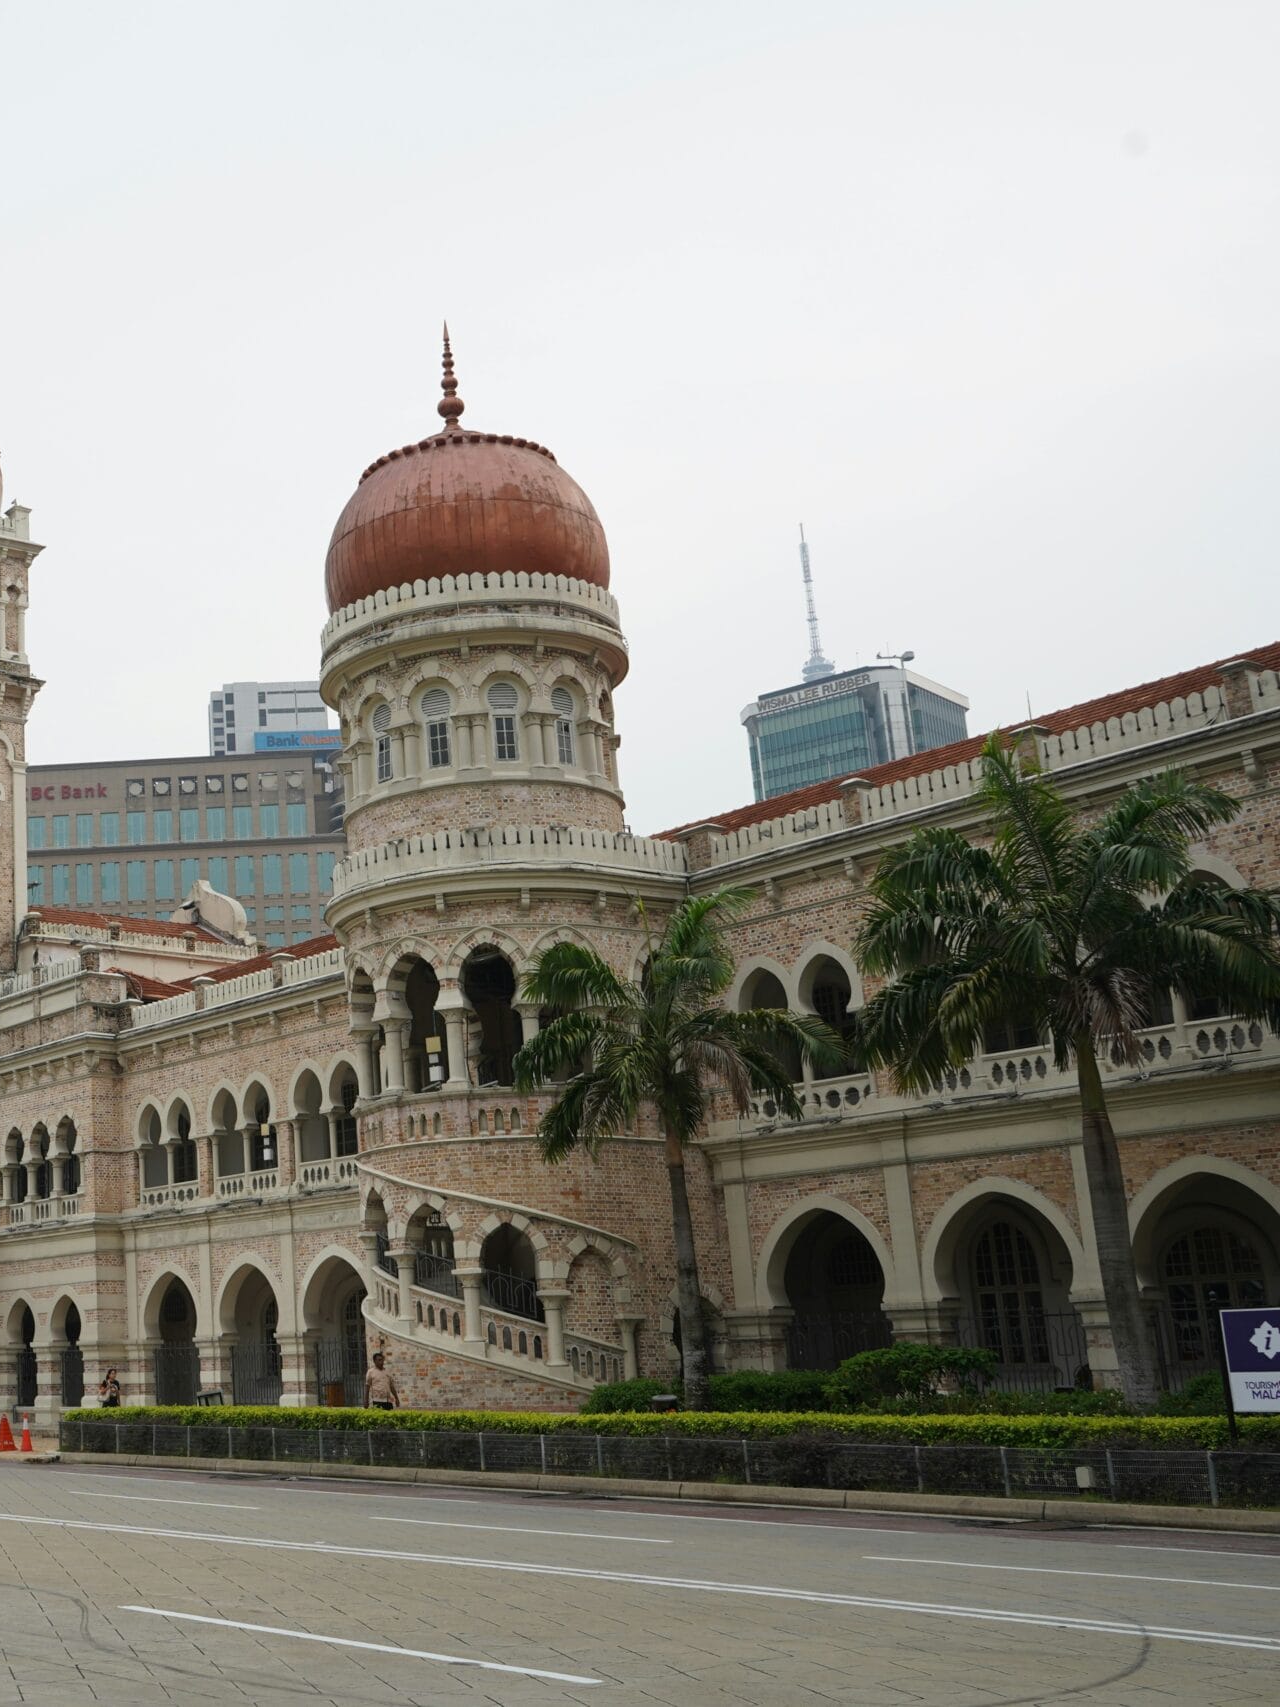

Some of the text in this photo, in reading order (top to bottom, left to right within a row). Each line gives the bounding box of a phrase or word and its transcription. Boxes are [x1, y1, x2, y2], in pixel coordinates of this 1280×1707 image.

[756, 673, 871, 712] WISMA LEE RUBBER
[266, 734, 299, 747] Bank
[26, 782, 108, 801] BC Bank
[1245, 1381, 1279, 1390] TOURISM
